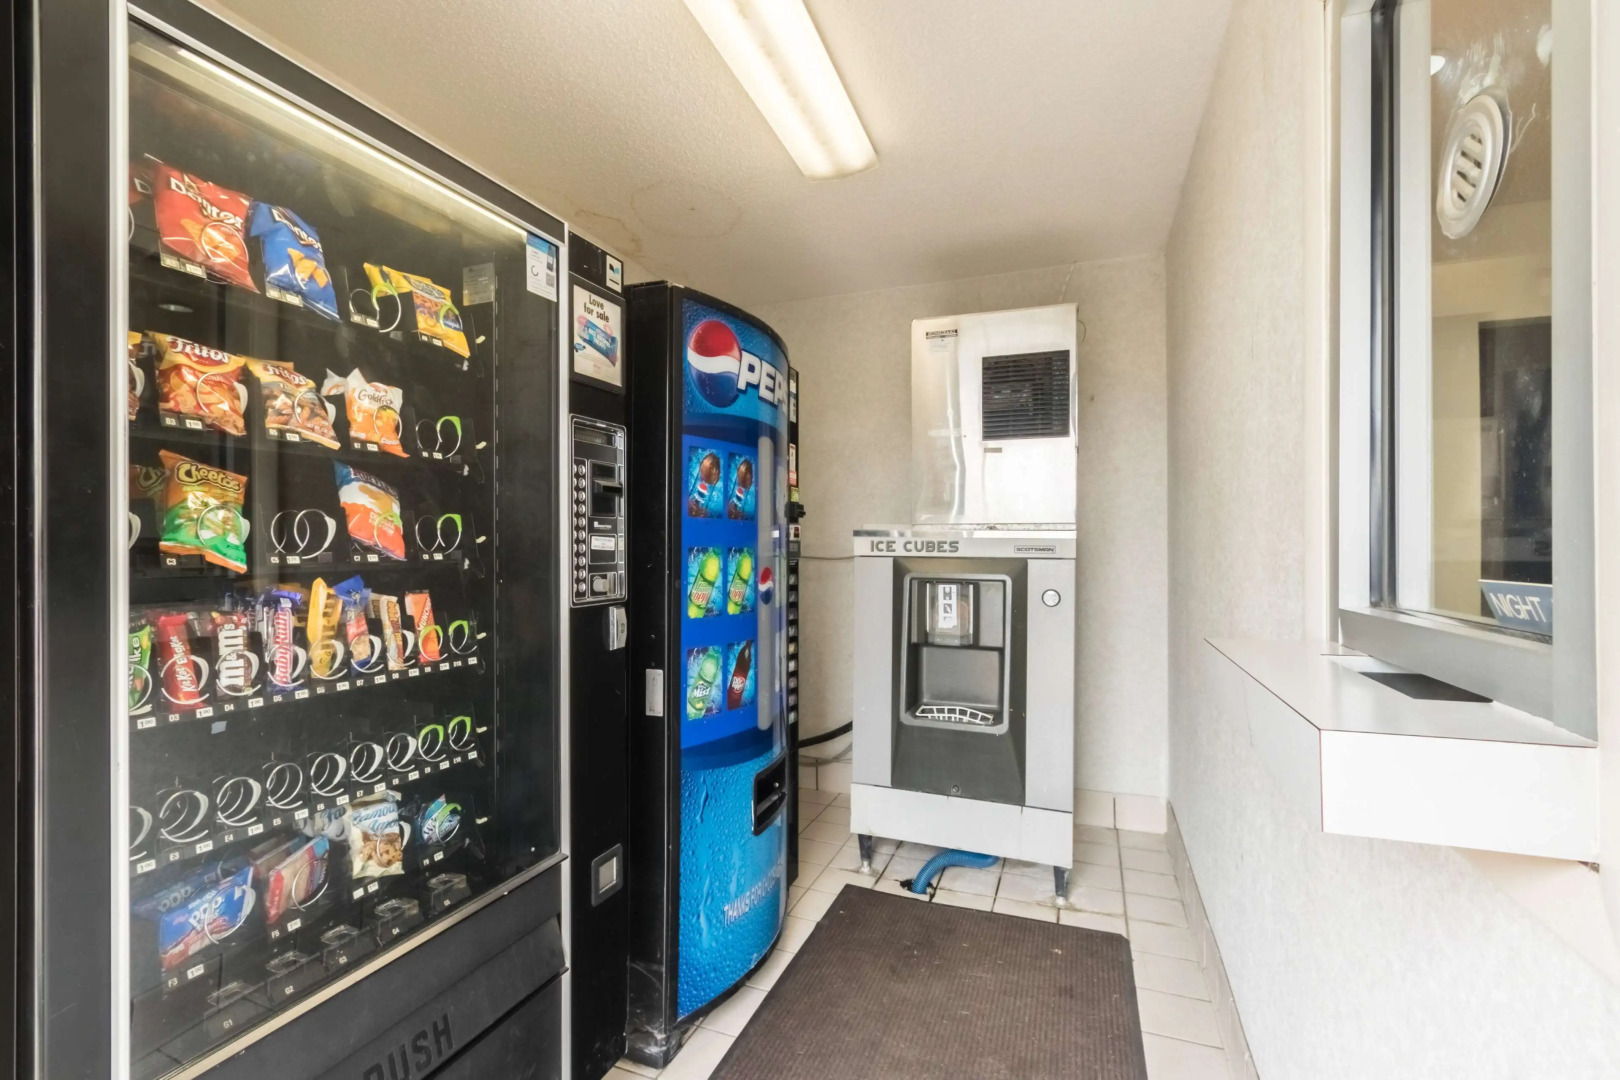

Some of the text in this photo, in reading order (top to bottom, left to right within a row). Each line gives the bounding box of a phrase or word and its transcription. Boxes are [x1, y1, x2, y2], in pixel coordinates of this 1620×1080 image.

[589, 294, 604, 309] Love
[584, 302, 609, 323] for sale
[166, 335, 229, 364] Fritos
[738, 350, 788, 412] PEP
[358, 389, 394, 406] Goldfish
[177, 463, 241, 491] Cheetos
[870, 540, 959, 553] ICE CUBES
[1489, 592, 1547, 623] NIGHT
[225, 834, 233, 842] E4
[272, 930, 279, 938] F5
[168, 978, 178, 987] F3
[285, 986, 294, 994] G2
[223, 1019, 233, 1028] G1
